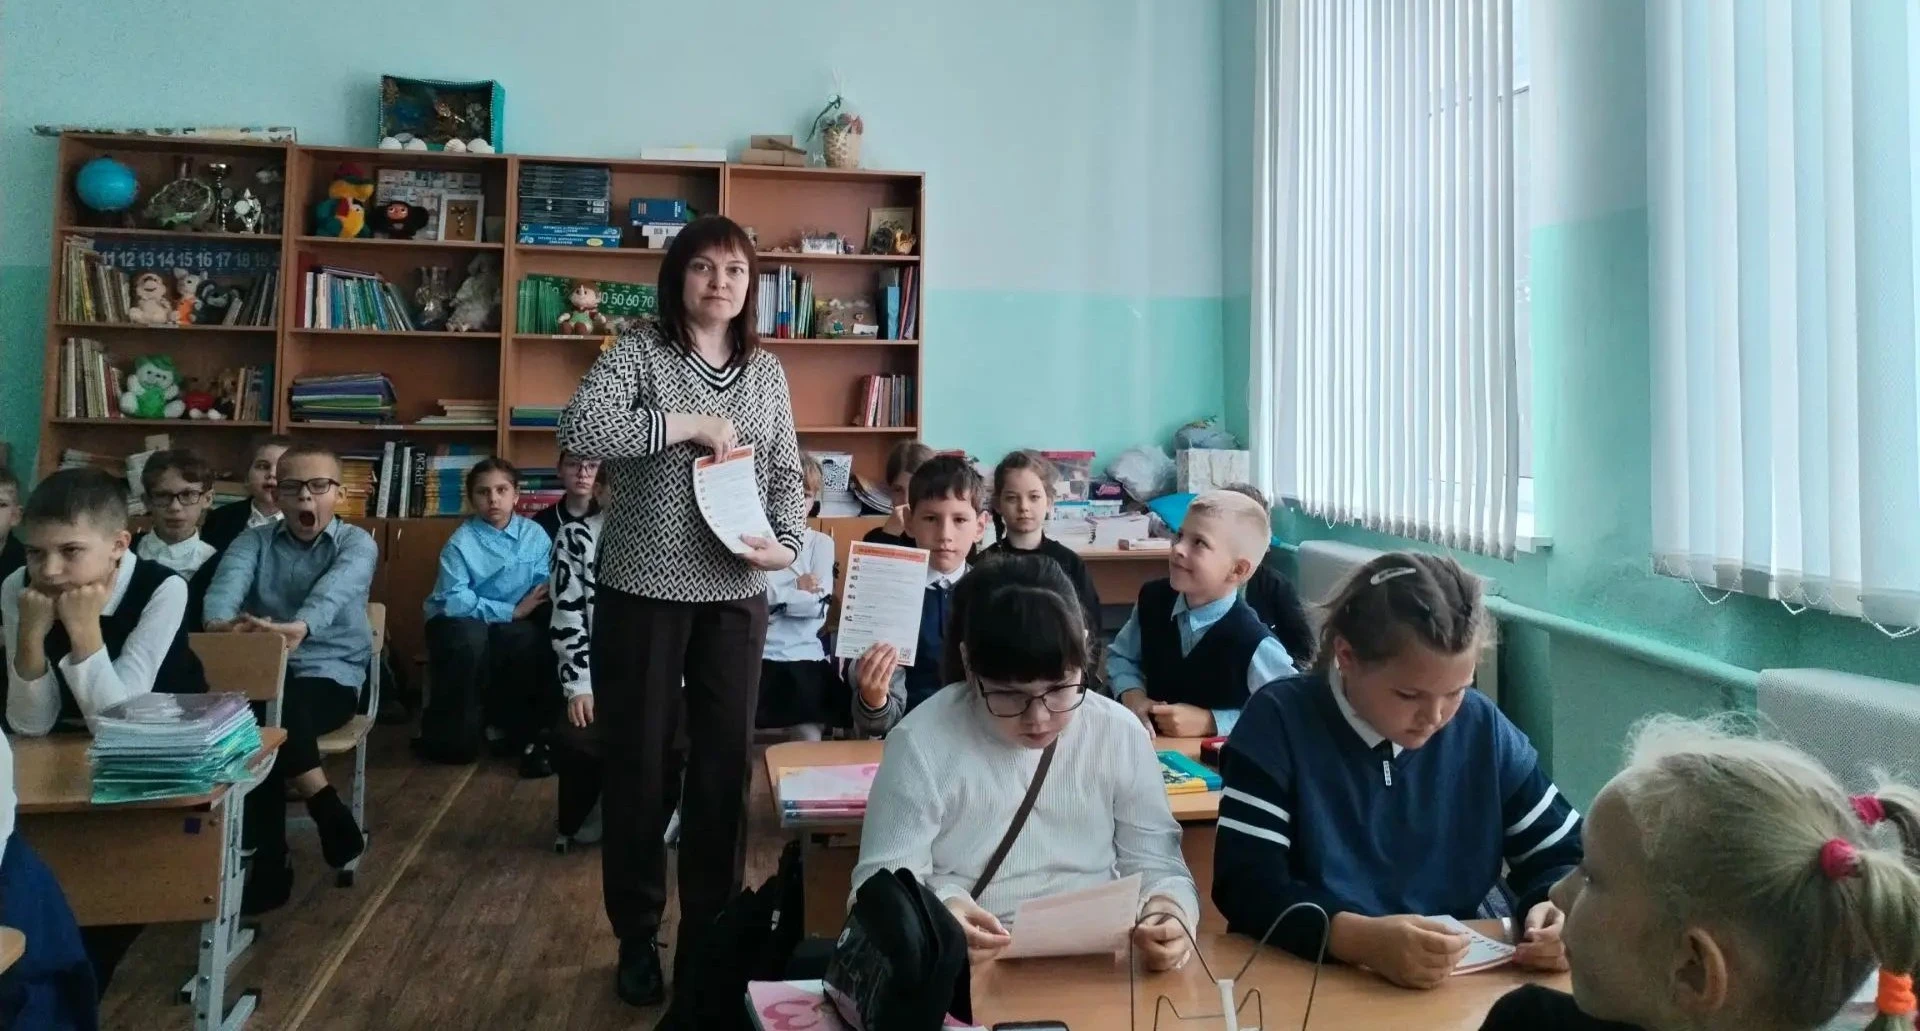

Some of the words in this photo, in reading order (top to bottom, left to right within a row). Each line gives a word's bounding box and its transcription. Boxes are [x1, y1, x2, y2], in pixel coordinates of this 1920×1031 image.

[101, 251, 116, 267] 11
[118, 251, 135, 267] 12
[138, 251, 154, 267] 13
[157, 251, 175, 267] 14
[177, 251, 193, 267] 15
[195, 252, 213, 267] 16
[215, 252, 232, 267] 17
[235, 252, 250, 267] 18
[611, 293, 624, 306] 50
[625, 294, 639, 307] 60
[641, 295, 655, 308] 70
[414, 452, 426, 485] БРЕМ
